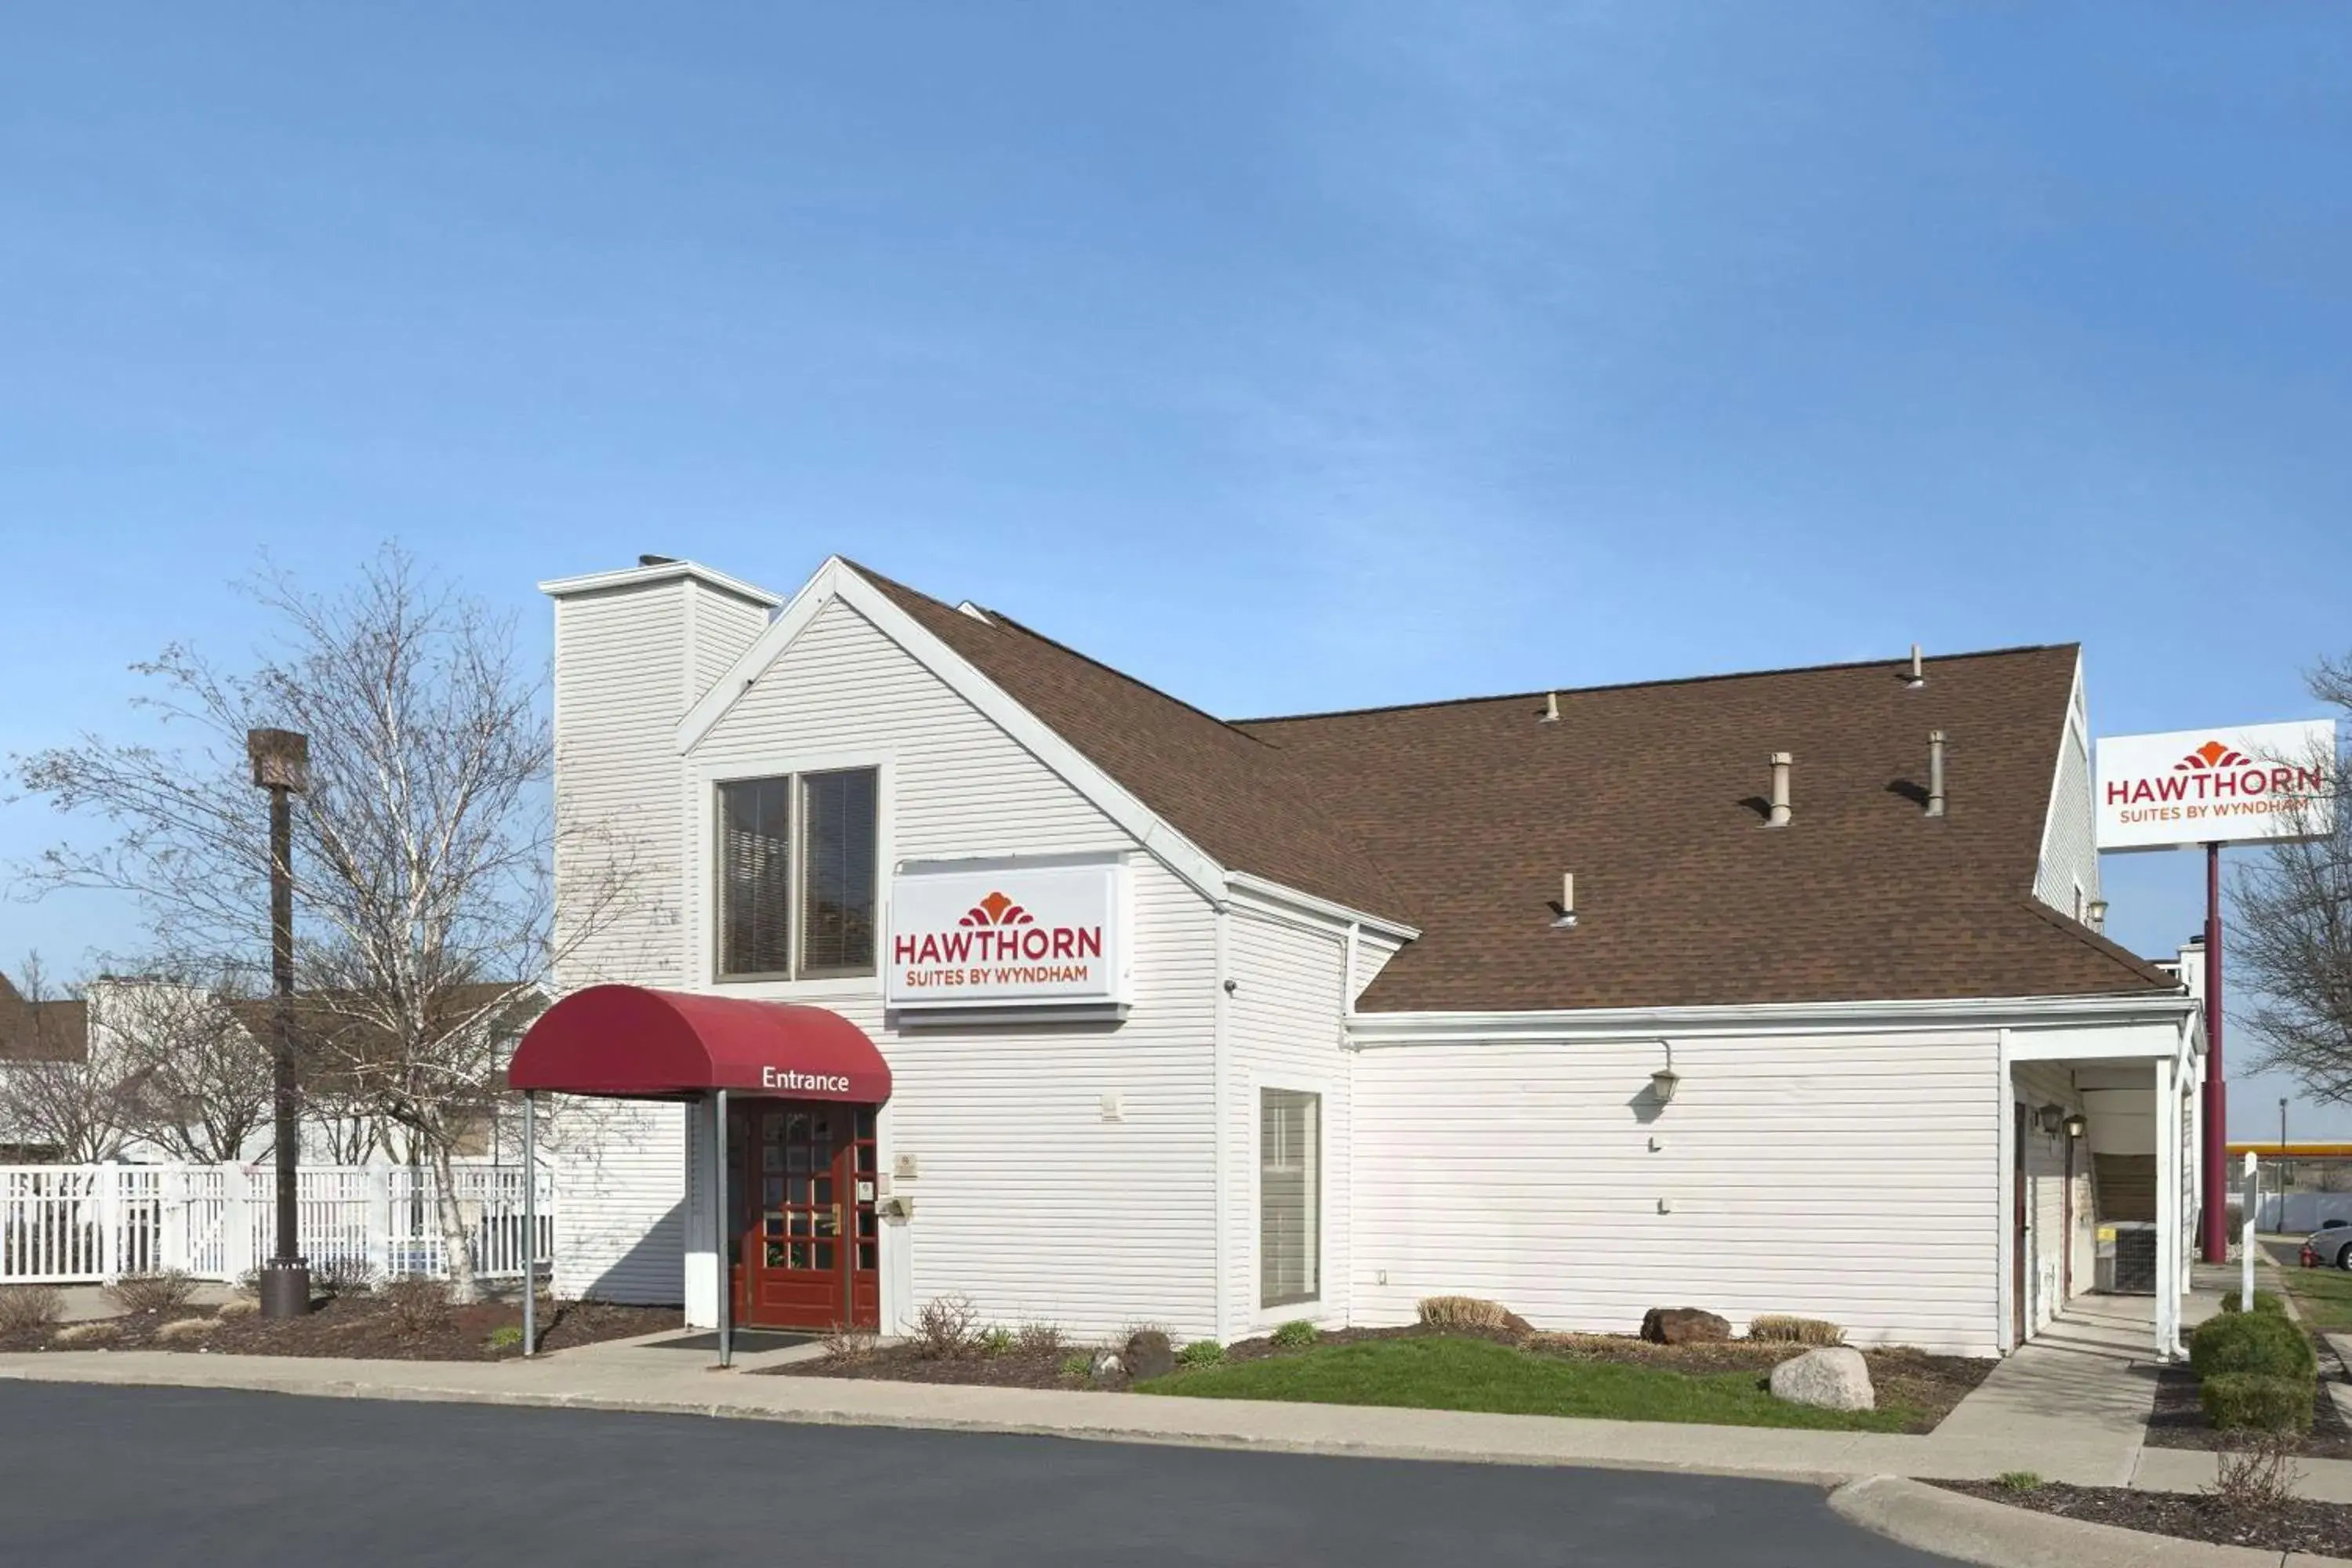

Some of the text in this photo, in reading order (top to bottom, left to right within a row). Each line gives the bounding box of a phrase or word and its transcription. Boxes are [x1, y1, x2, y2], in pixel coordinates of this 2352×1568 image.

[2107, 767, 2321, 805] HAWTHORN
[2120, 798, 2309, 823] SUITES BY WYNDHAM
[895, 927, 1102, 965] HAWTHORN
[906, 965, 1088, 987] SUITES BY WYNDHAM
[762, 1065, 849, 1092] Entrance
